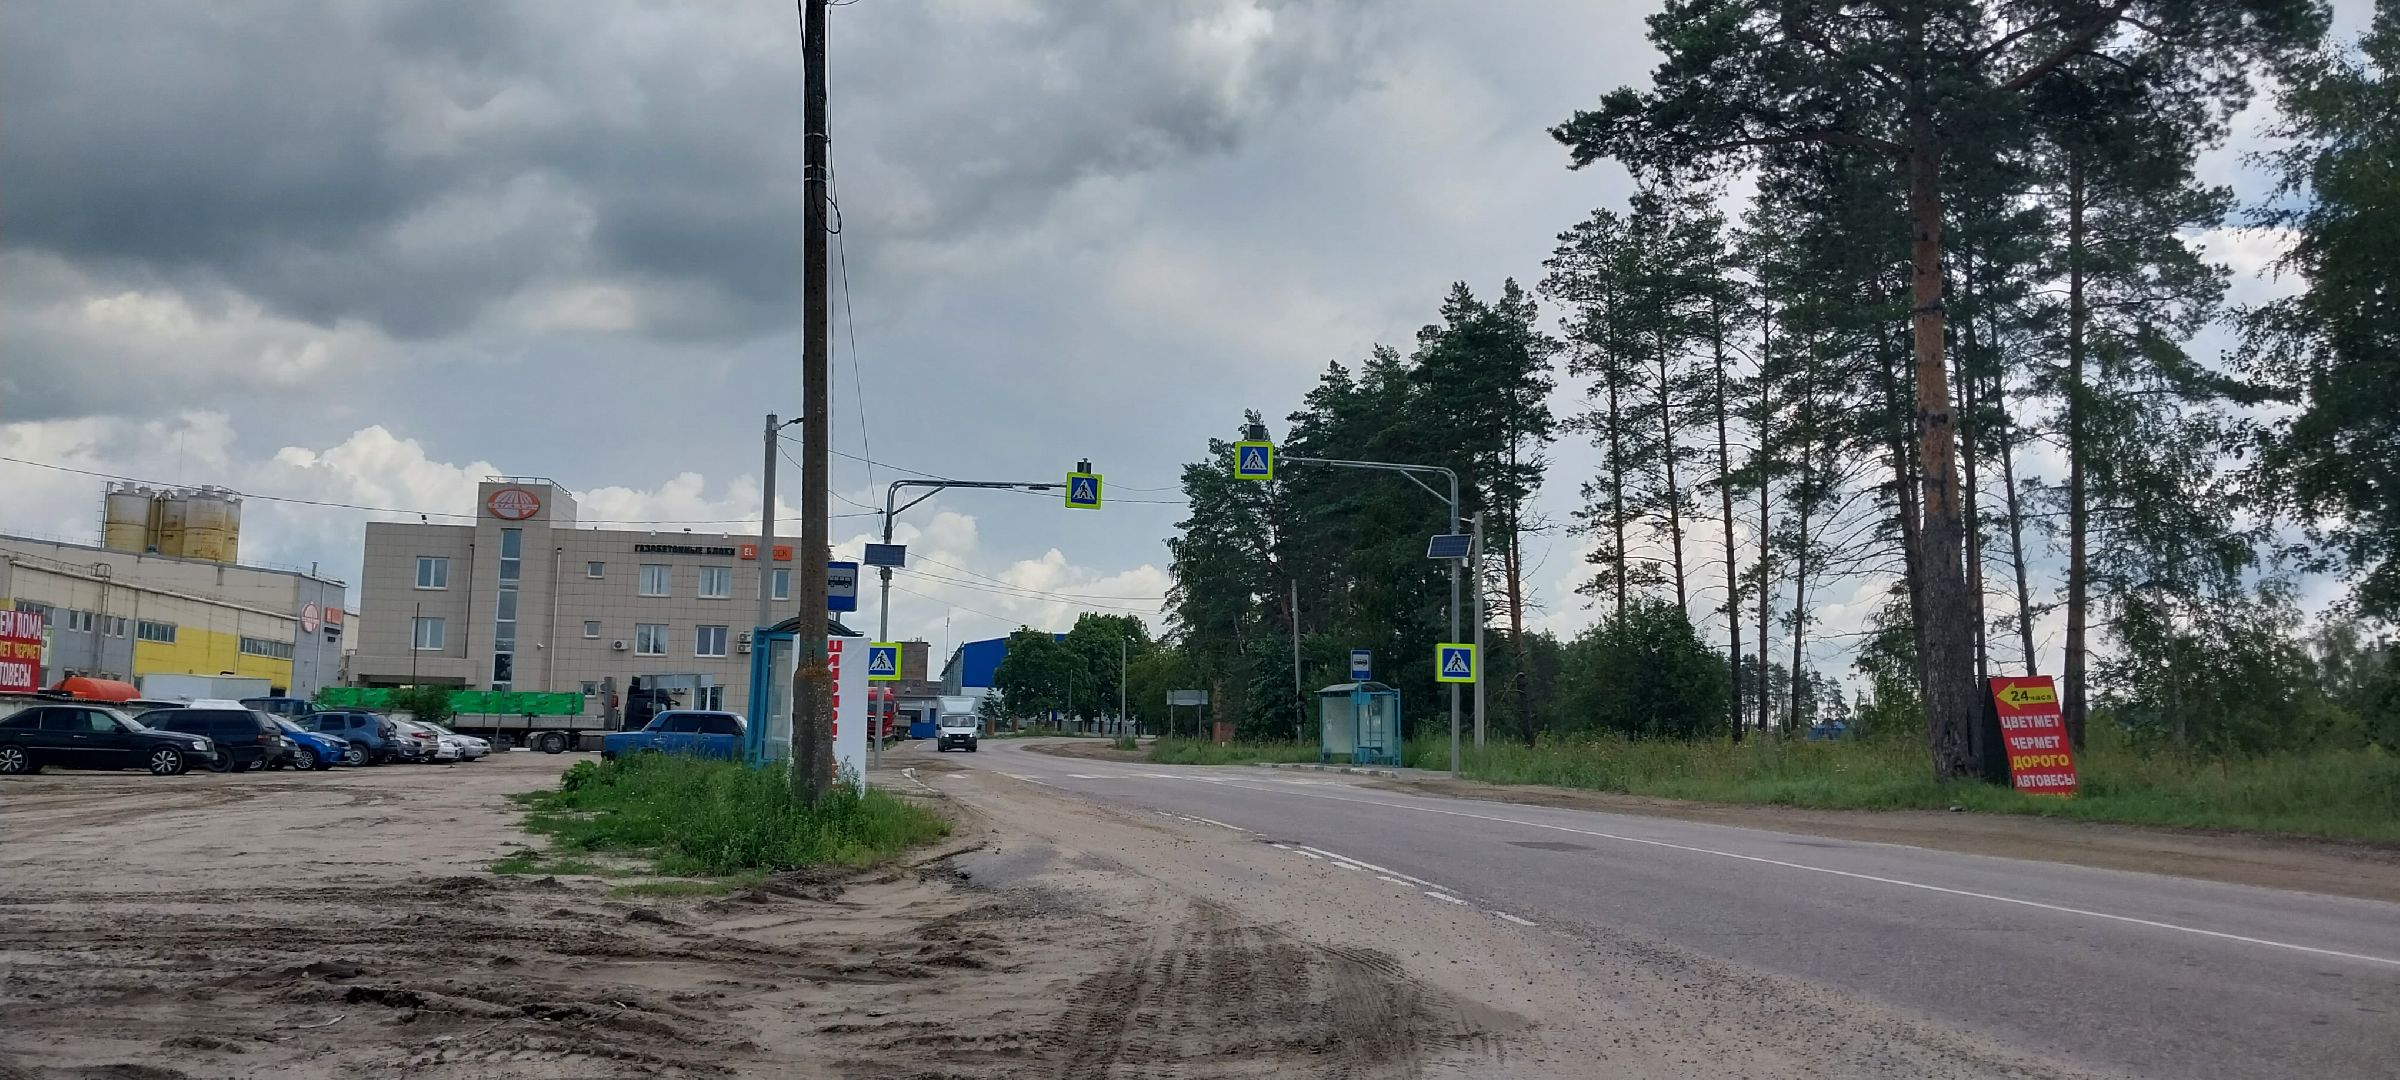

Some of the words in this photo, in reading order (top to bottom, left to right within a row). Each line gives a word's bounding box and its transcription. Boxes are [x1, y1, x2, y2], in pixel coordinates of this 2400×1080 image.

[744, 547, 753, 556] EL
[15, 613, 42, 640] ЛОМА
[15, 643, 41, 660] ЧЕРМЕТ
[2010, 690, 2028, 702] 24
[2000, 714, 2059, 731] ЦВЕТМЕТ
[2010, 735, 2060, 749] ЧЕРМЕТ
[2012, 754, 2069, 770] ДОРОГО
[2016, 773, 2076, 788] АВТОВЕСЫ
